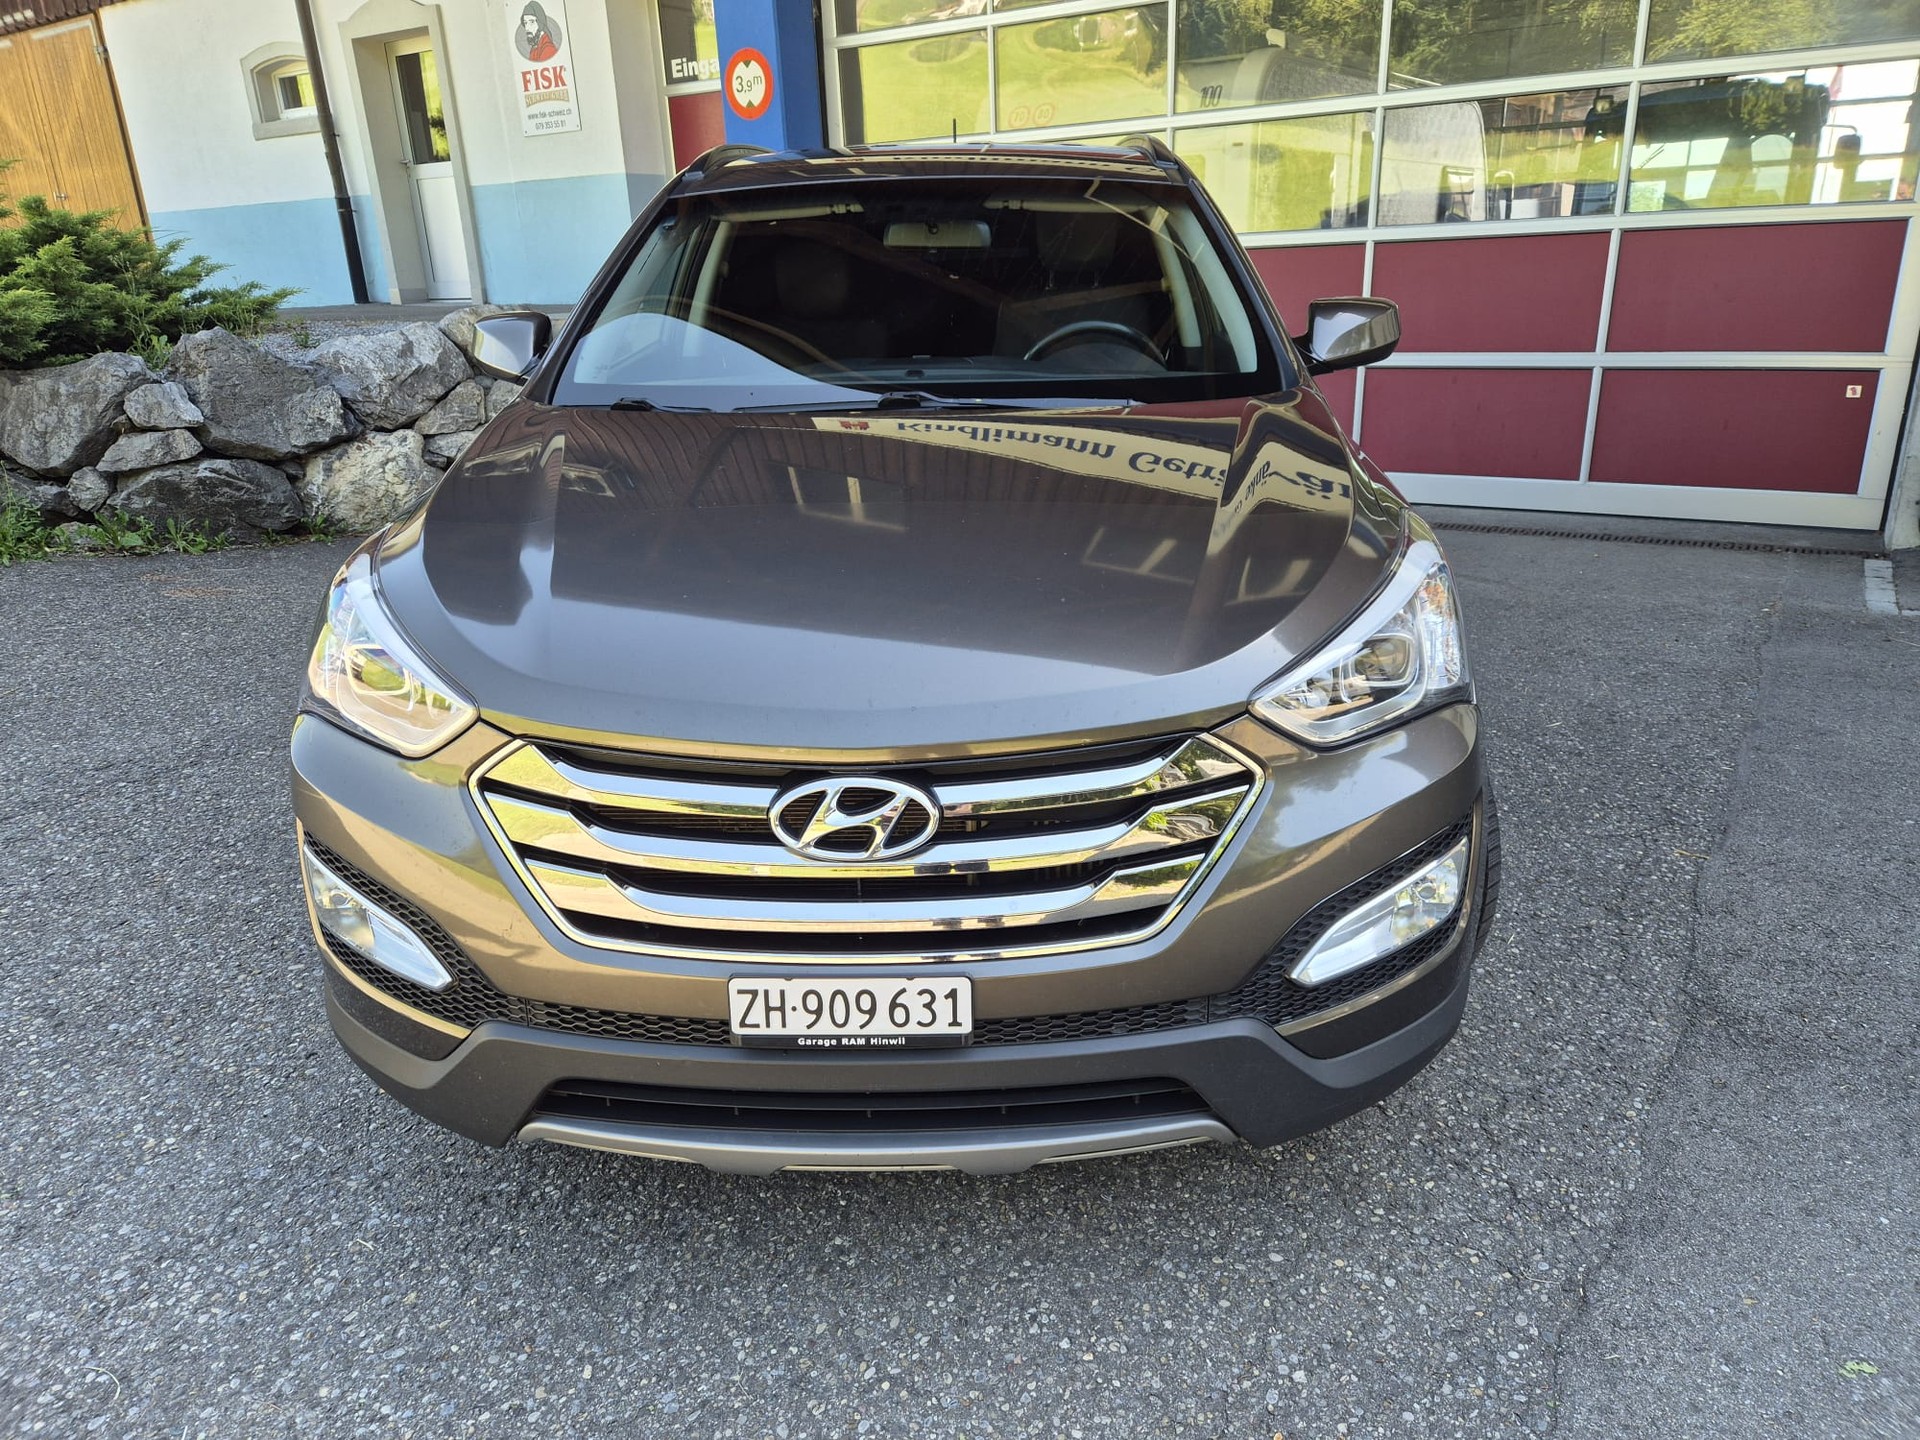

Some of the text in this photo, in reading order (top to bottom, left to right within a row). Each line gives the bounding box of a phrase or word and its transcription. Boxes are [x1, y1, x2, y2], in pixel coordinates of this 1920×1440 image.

[521, 65, 567, 92] FISK
[797, 1037, 906, 1047] Garage RAM Hinwil
